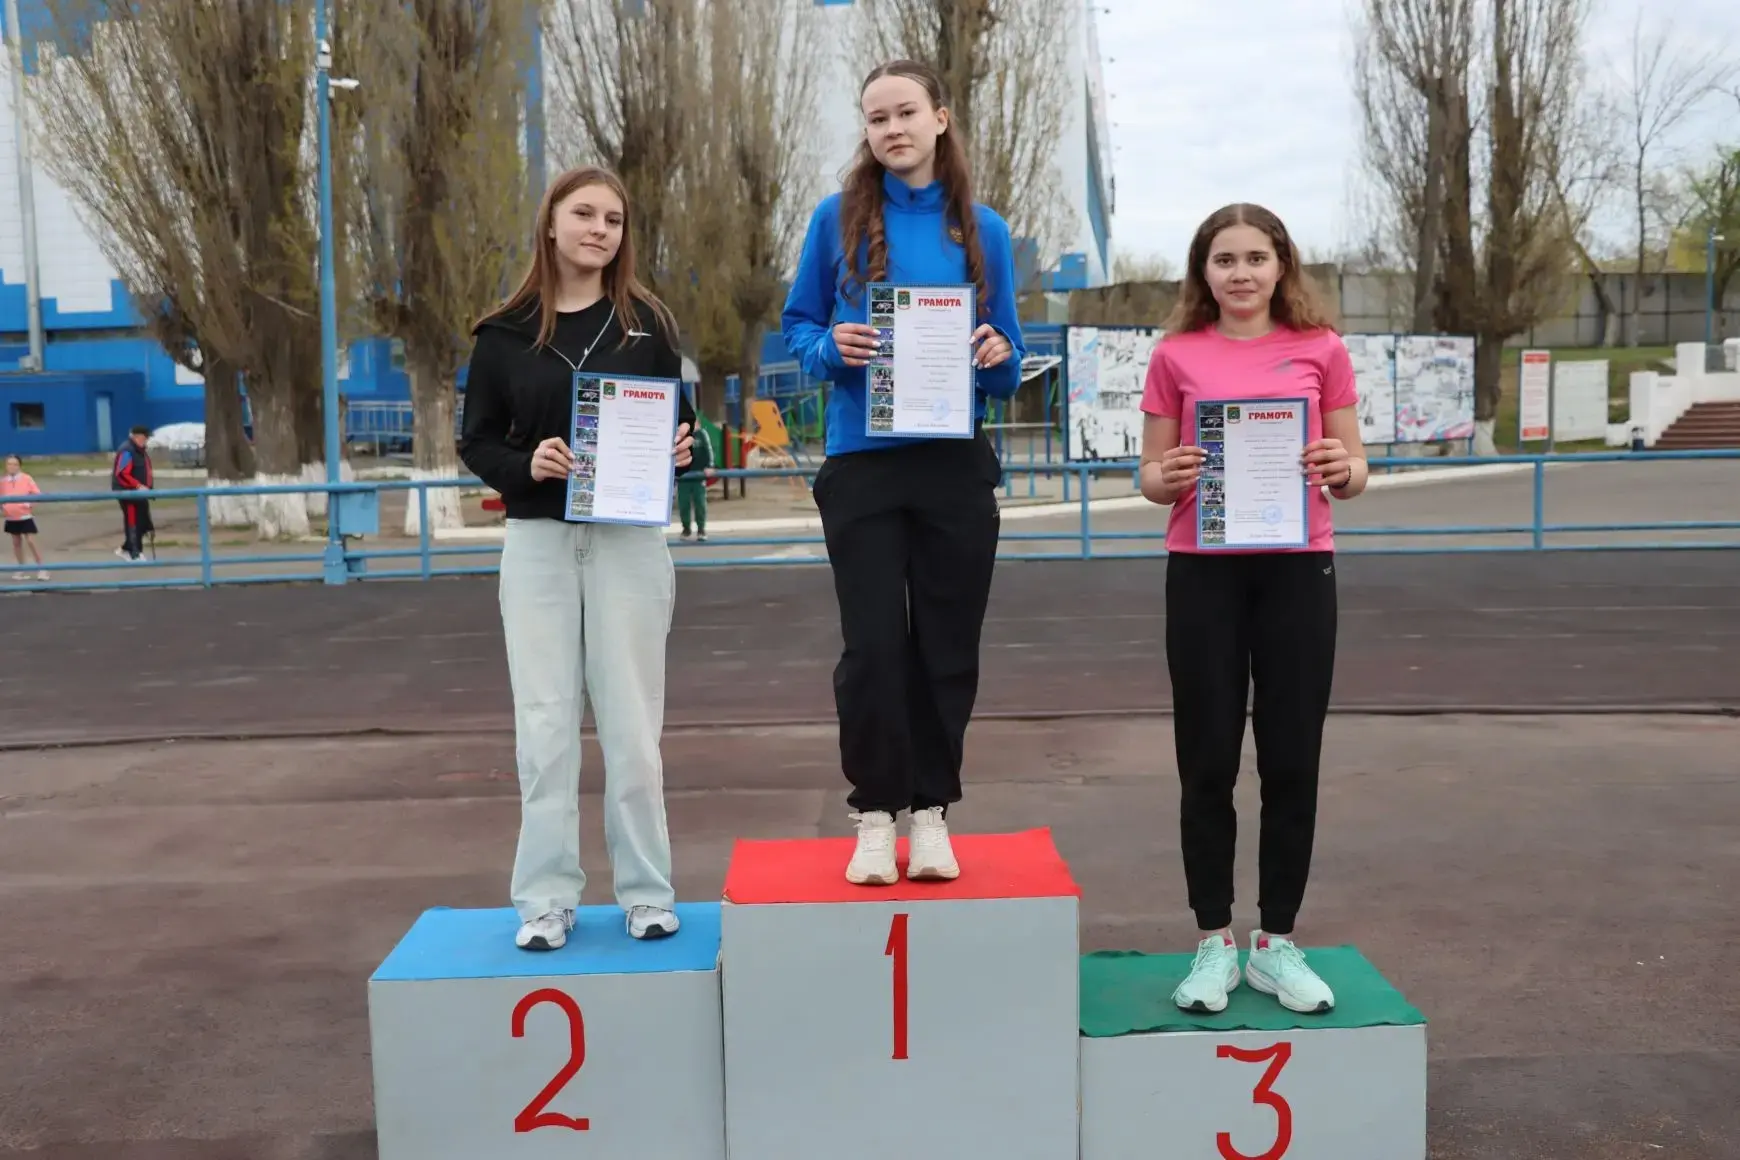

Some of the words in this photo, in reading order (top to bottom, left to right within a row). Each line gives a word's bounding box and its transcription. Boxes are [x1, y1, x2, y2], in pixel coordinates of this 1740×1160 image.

[918, 298, 962, 307] ГРАМОТА
[623, 389, 666, 400] ГРАМОТА
[1248, 411, 1294, 420] ГРАМОТА
[885, 914, 909, 1060] 1
[511, 988, 590, 1133] 2
[1216, 1042, 1293, 1160] 3
